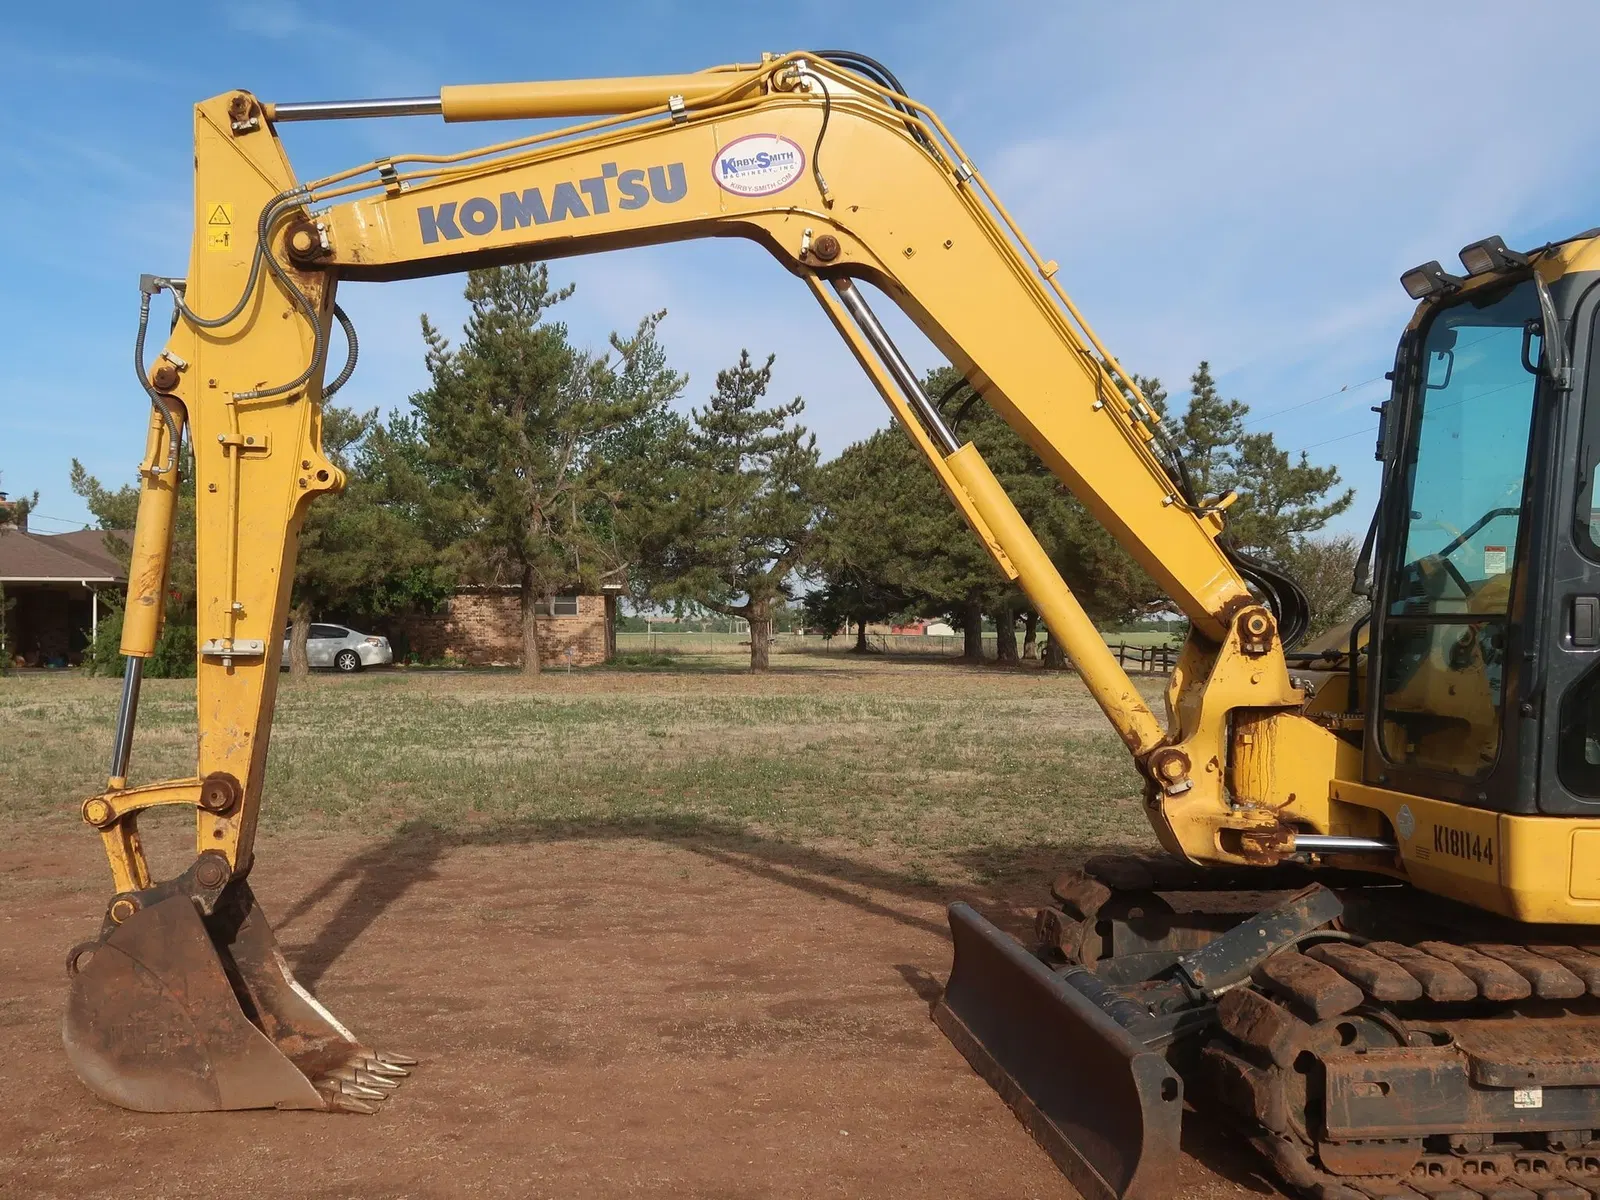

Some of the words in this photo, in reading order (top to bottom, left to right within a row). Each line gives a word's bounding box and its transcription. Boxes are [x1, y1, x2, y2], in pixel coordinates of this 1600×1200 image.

[417, 162, 688, 244] KOMATSU
[730, 173, 792, 192] KIRBY-SMITH.COM
[1434, 824, 1493, 865] K181144
